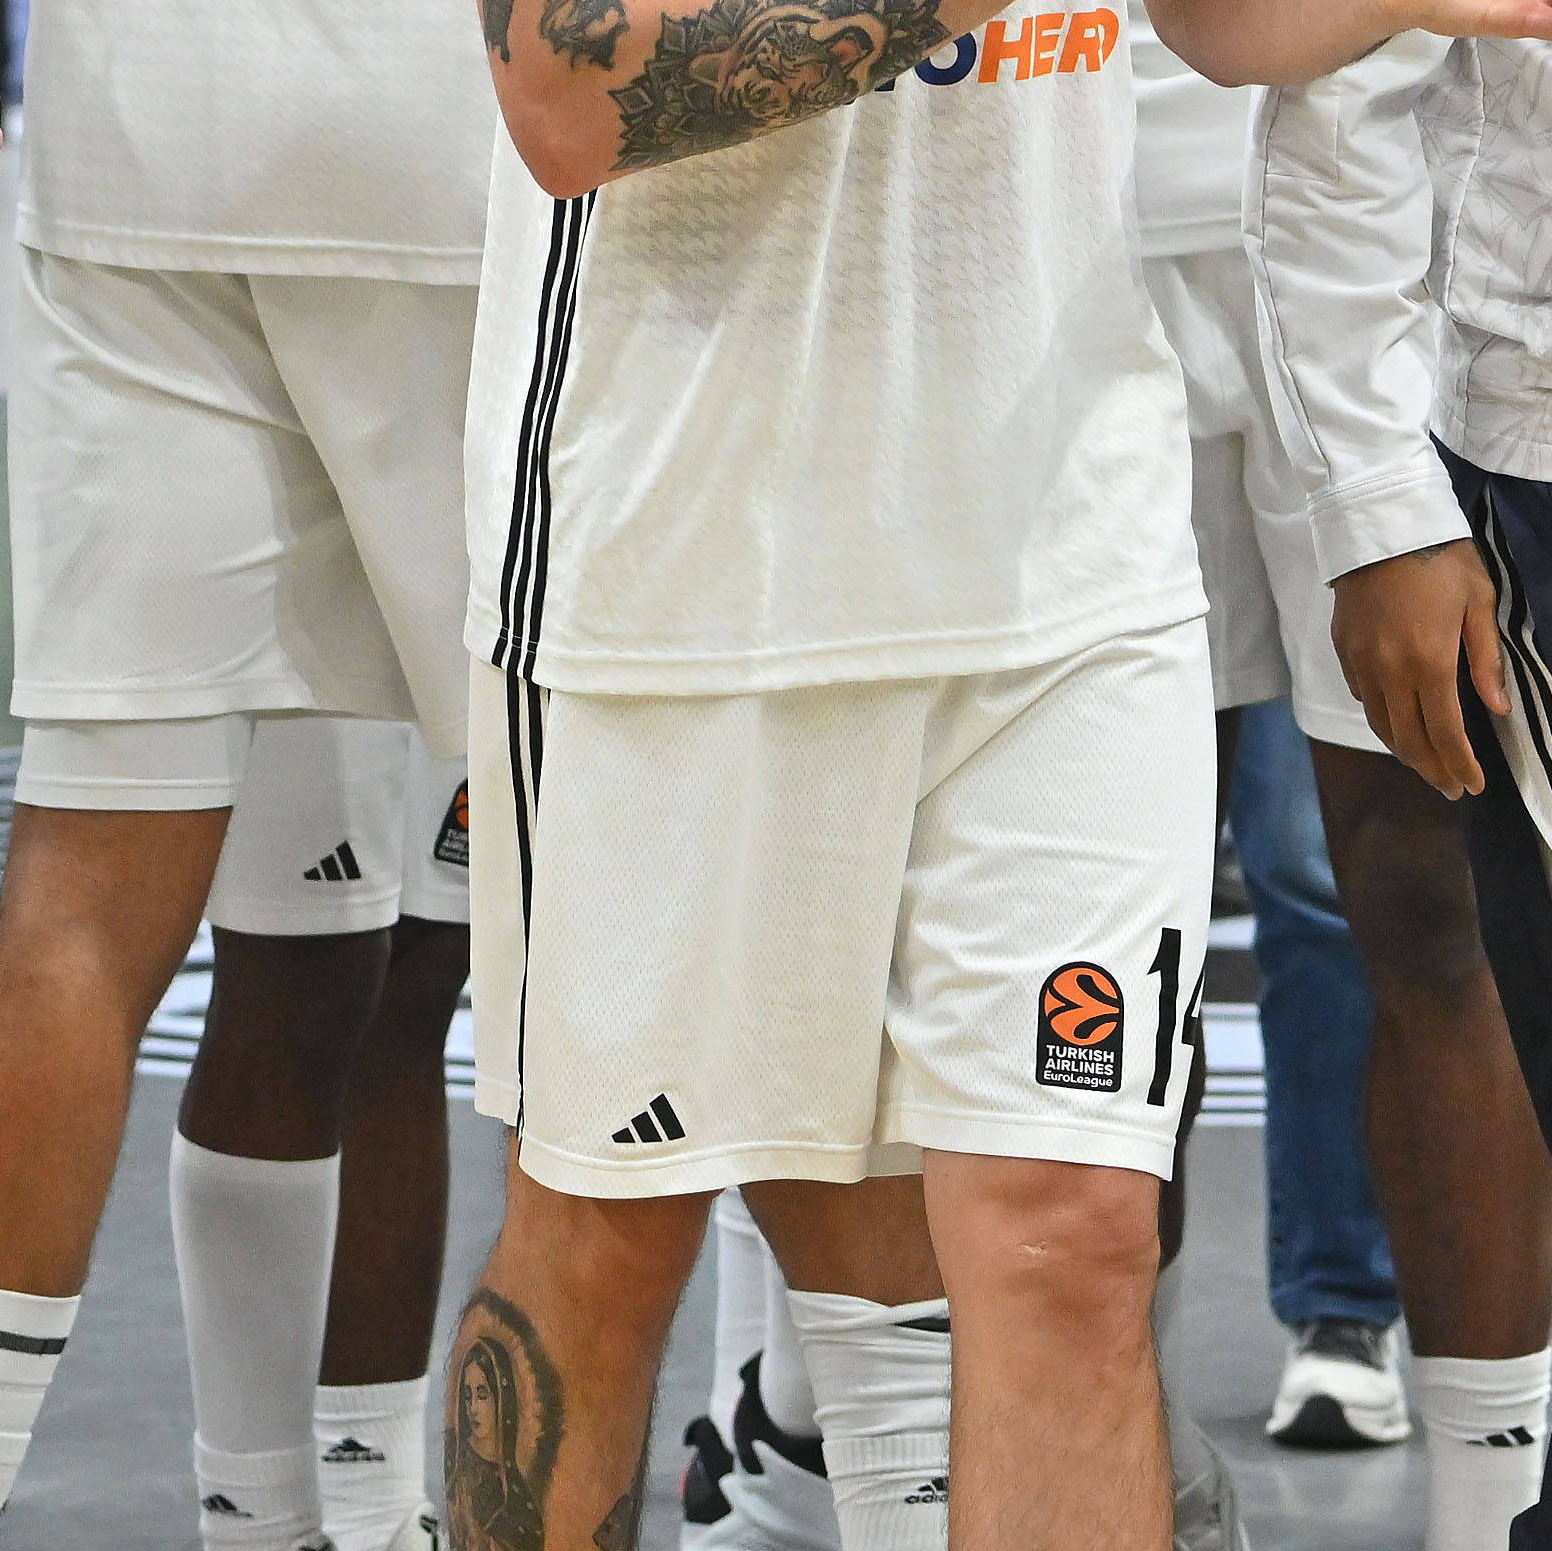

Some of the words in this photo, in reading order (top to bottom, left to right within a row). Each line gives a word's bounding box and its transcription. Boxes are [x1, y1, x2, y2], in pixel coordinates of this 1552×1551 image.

[1046, 1044, 1115, 1063] TURKISH
[1044, 1058, 1115, 1076] AIRLINES
[1043, 1070, 1114, 1088] EuroLeague
